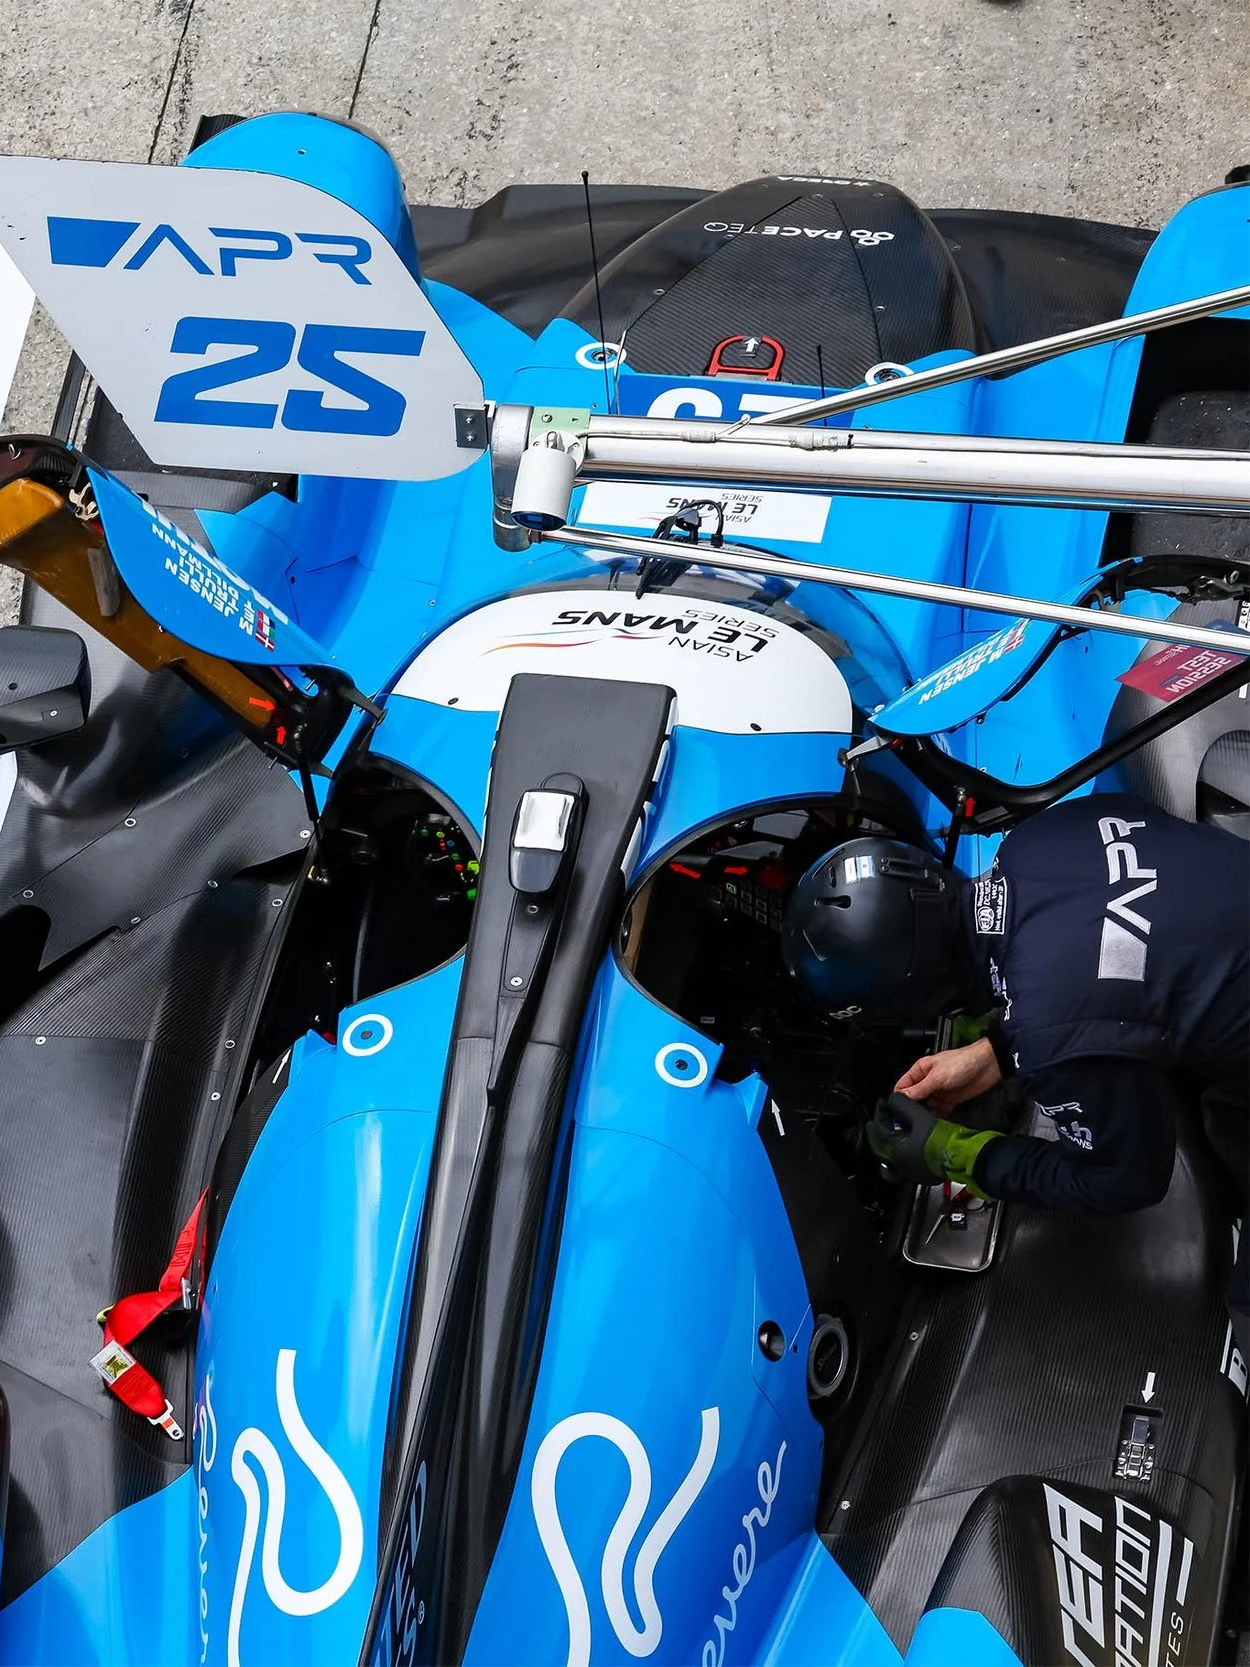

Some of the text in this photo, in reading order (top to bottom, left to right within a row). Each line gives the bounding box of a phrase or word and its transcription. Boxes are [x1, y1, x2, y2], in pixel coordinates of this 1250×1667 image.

[123, 223, 372, 285] APR
[703, 221, 843, 240] PACETEQ
[154, 316, 426, 437] 25
[720, 492, 763, 503] SERIES
[732, 503, 758, 515] LE
[152, 523, 239, 599] DILLMANN
[164, 557, 254, 636] M JENSEN
[177, 556, 254, 622] E TRULLI
[551, 610, 768, 653] LE MANS
[667, 636, 754, 662] ASIAN
[677, 609, 780, 639] SERIES
[1097, 816, 1158, 935] APR
